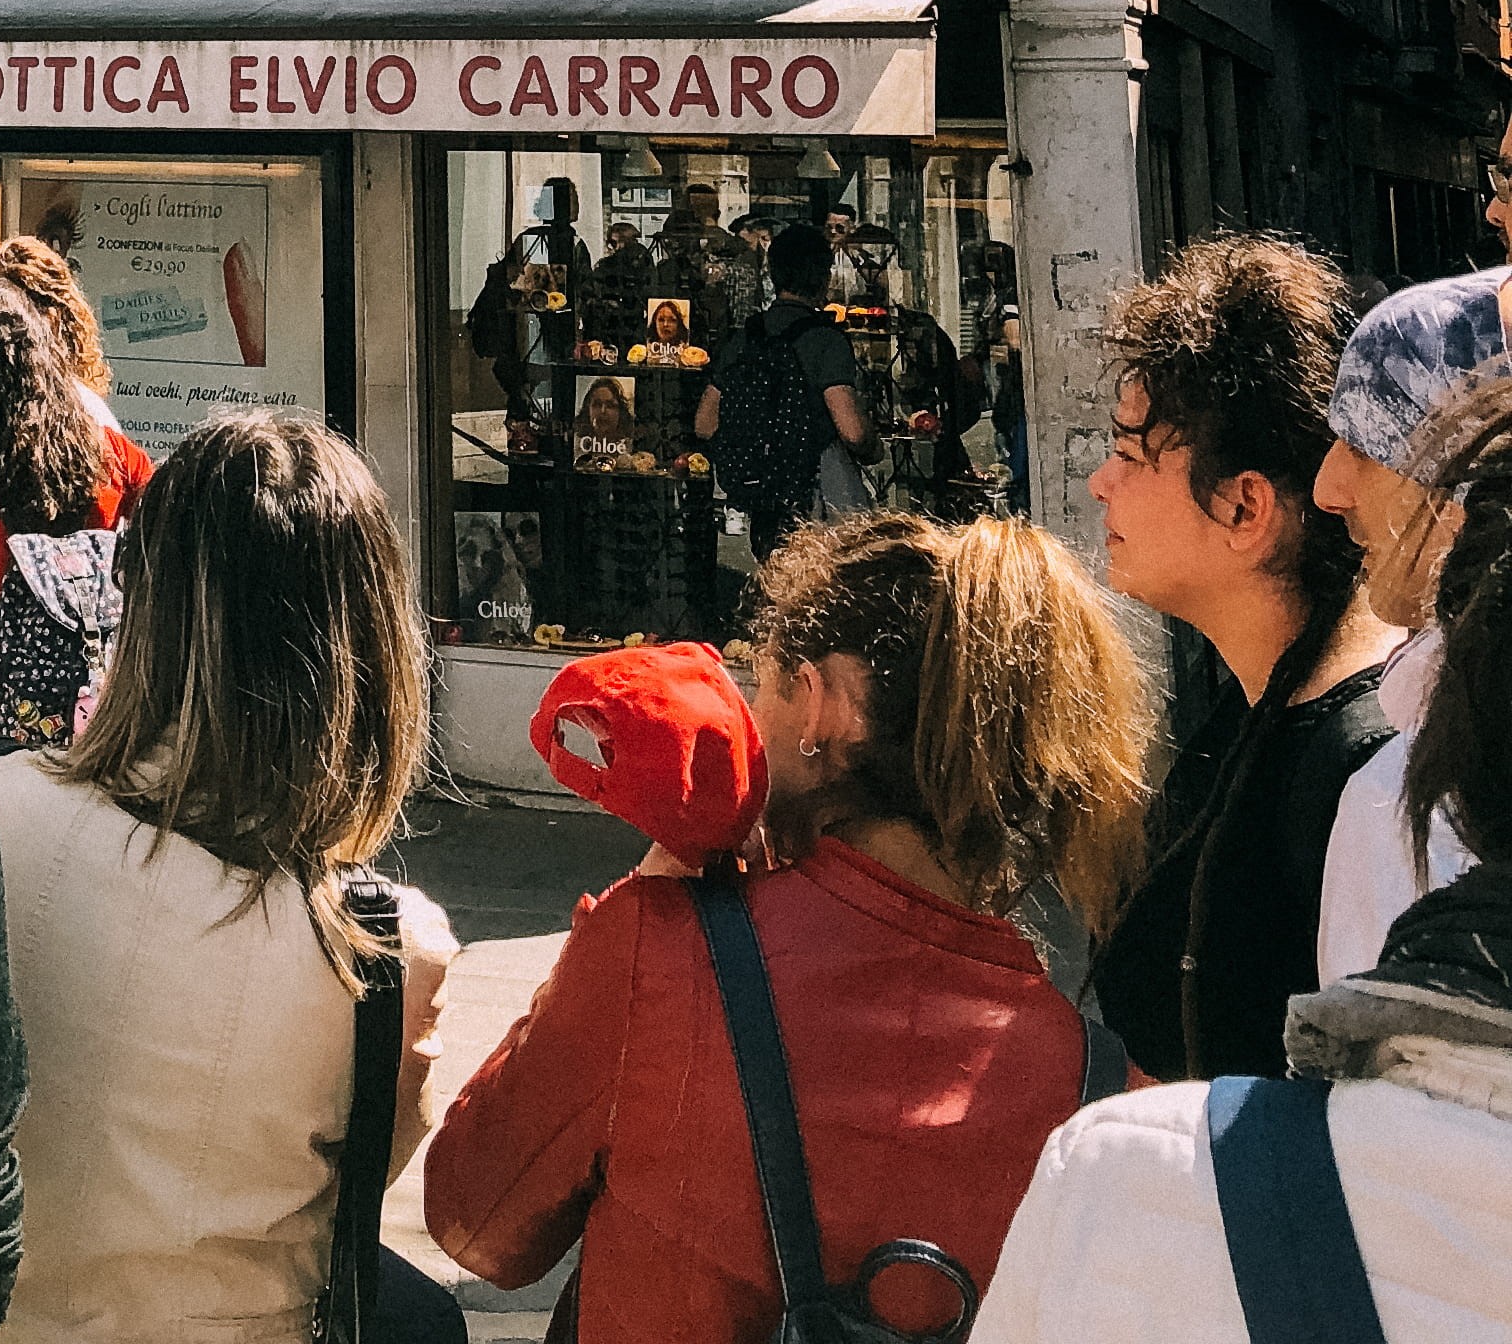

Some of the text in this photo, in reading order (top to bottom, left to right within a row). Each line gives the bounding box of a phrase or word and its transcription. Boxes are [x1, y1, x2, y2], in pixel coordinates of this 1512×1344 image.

[230, 54, 417, 115] ELVIO
[458, 54, 840, 120] CARRARO
[106, 193, 223, 226] Cogli l'attimo
[97, 236, 105, 249] 2
[106, 239, 163, 251] CONFEZIONI
[579, 435, 627, 455] Chloé
[477, 600, 532, 619] Chloé
